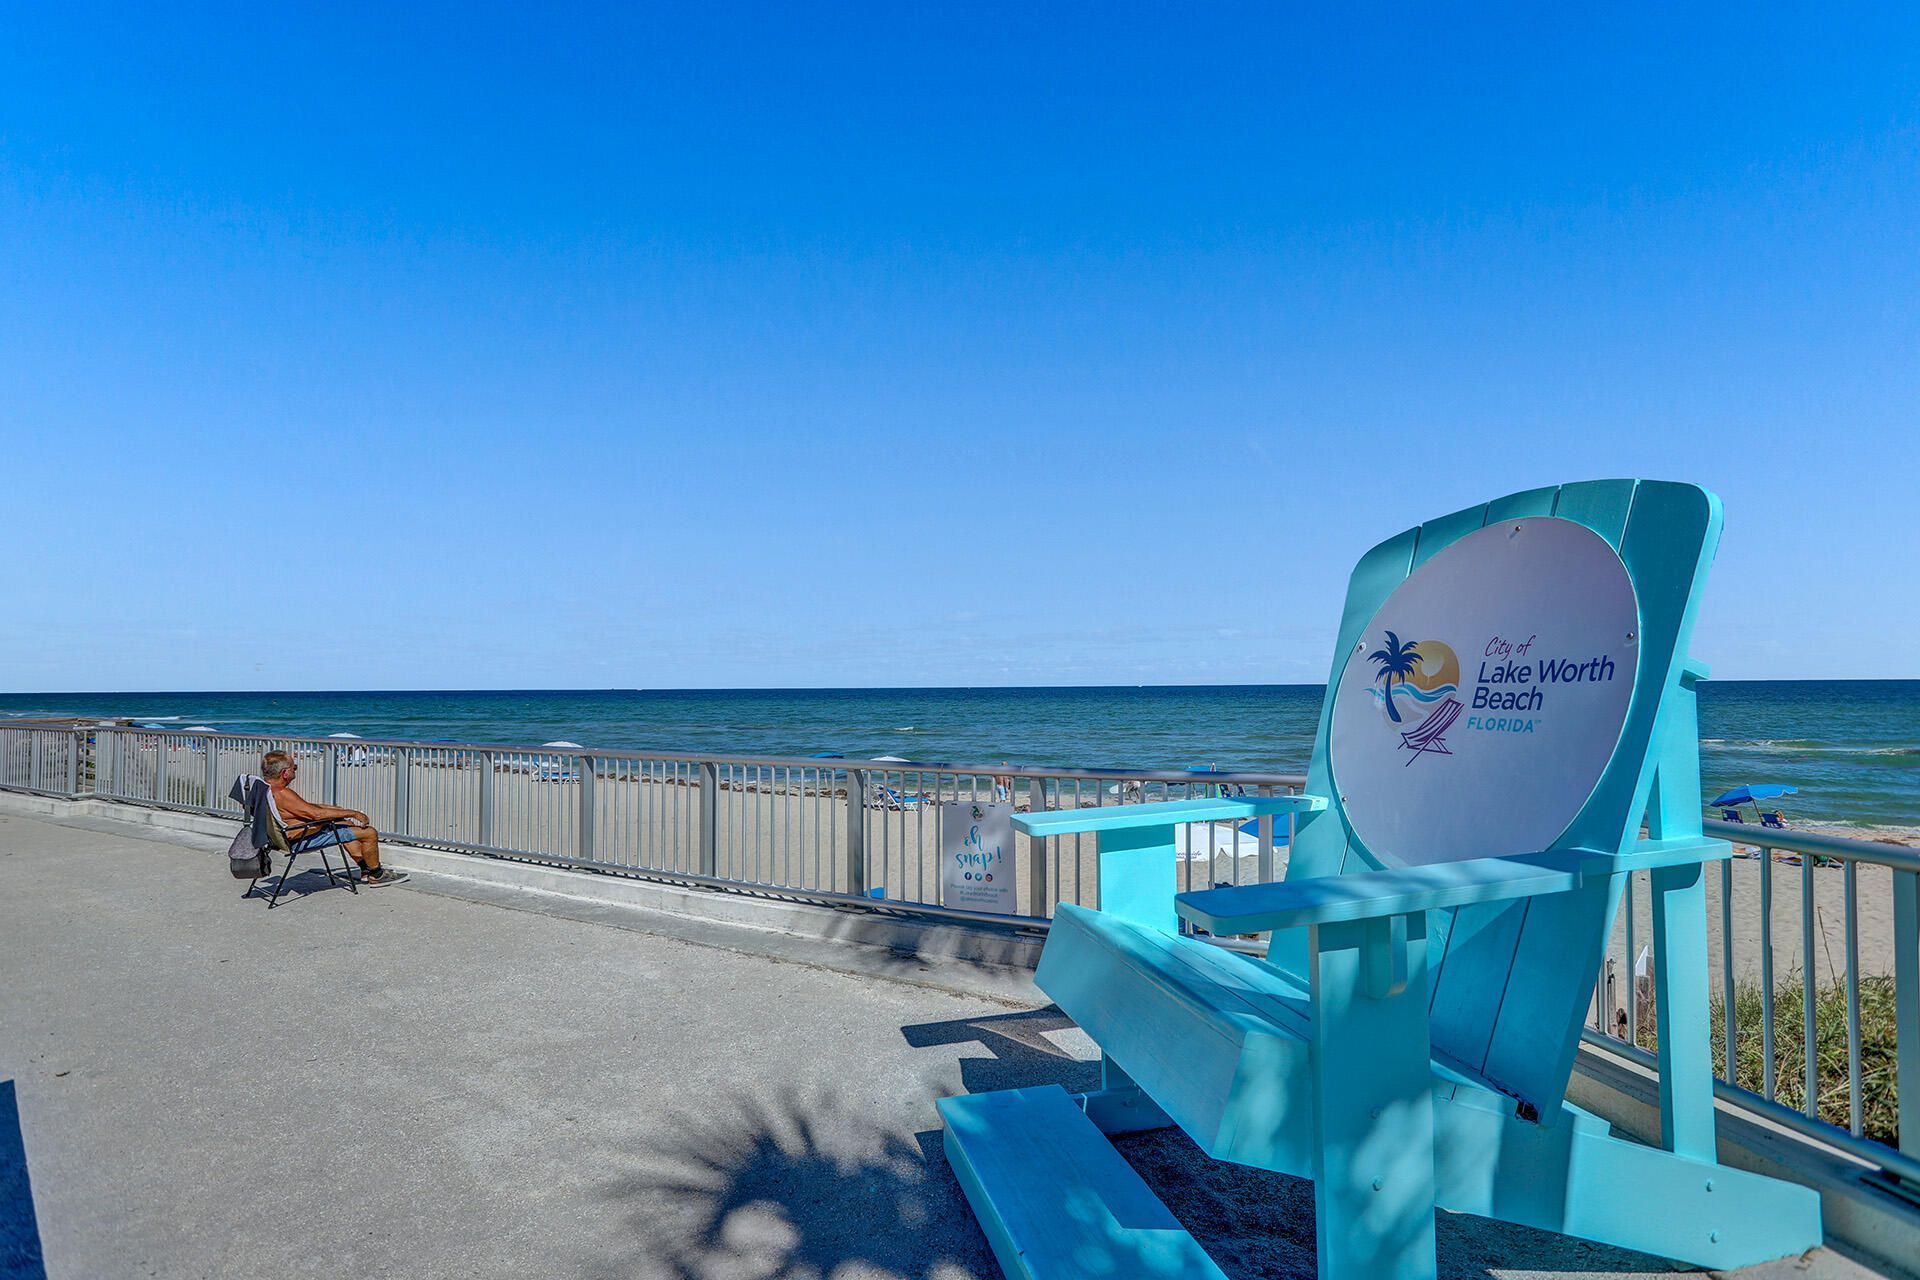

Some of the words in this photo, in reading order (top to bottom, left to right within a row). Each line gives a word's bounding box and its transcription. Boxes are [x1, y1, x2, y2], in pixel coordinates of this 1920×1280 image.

[1484, 636, 1513, 662] City
[1516, 634, 1536, 656] of
[1478, 660, 1532, 684] Lake
[1538, 655, 1615, 683] Worth
[1471, 685, 1544, 711] Beach
[955, 846, 1002, 871] snap!
